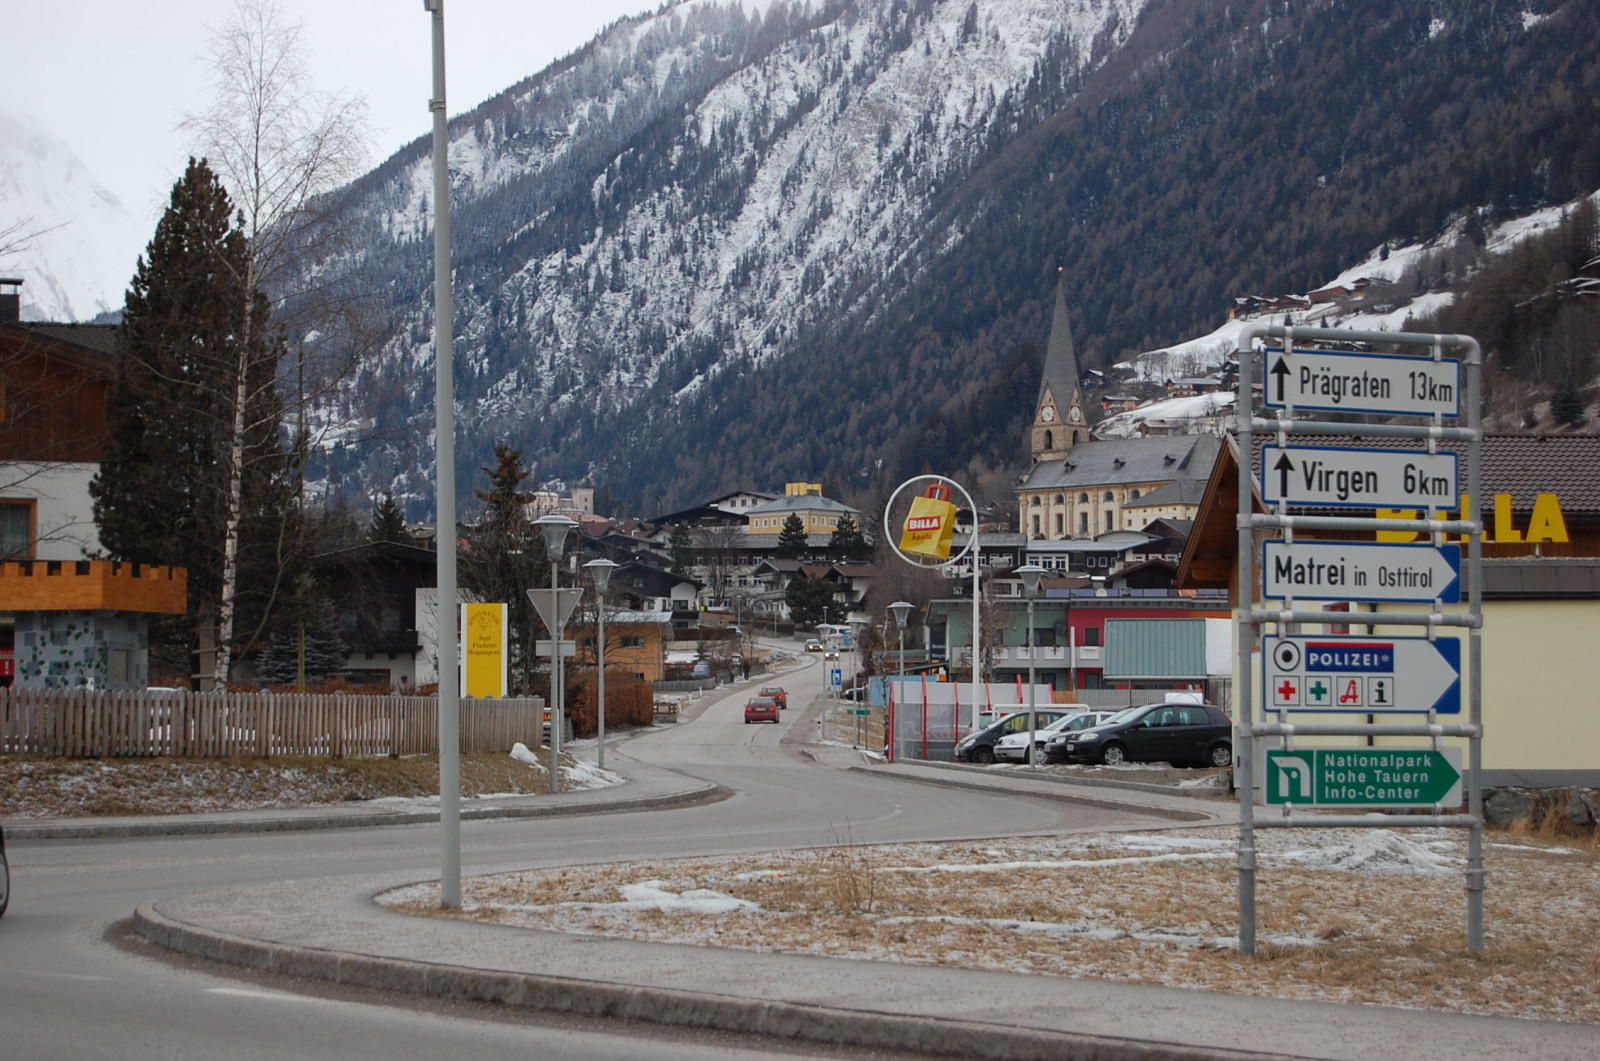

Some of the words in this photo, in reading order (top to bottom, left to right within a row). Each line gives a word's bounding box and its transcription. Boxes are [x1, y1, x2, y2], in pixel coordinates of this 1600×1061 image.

[1300, 365, 1391, 404] Prägraten
[1408, 371, 1453, 402] 13km
[1302, 460, 1378, 501] Virgen
[1403, 463, 1449, 496] 6km
[909, 518, 939, 530] BILLA
[1376, 492, 1569, 543] BLLA
[1275, 554, 1345, 586] Matrei
[1354, 565, 1367, 587] in
[1378, 565, 1433, 588] Osttirol
[1309, 652, 1379, 667] POLIZEI
[1325, 753, 1432, 769] Nationalpark
[1325, 769, 1366, 783] Hohe
[1374, 769, 1429, 783] Tauern
[1325, 785, 1420, 799] Info-Center
